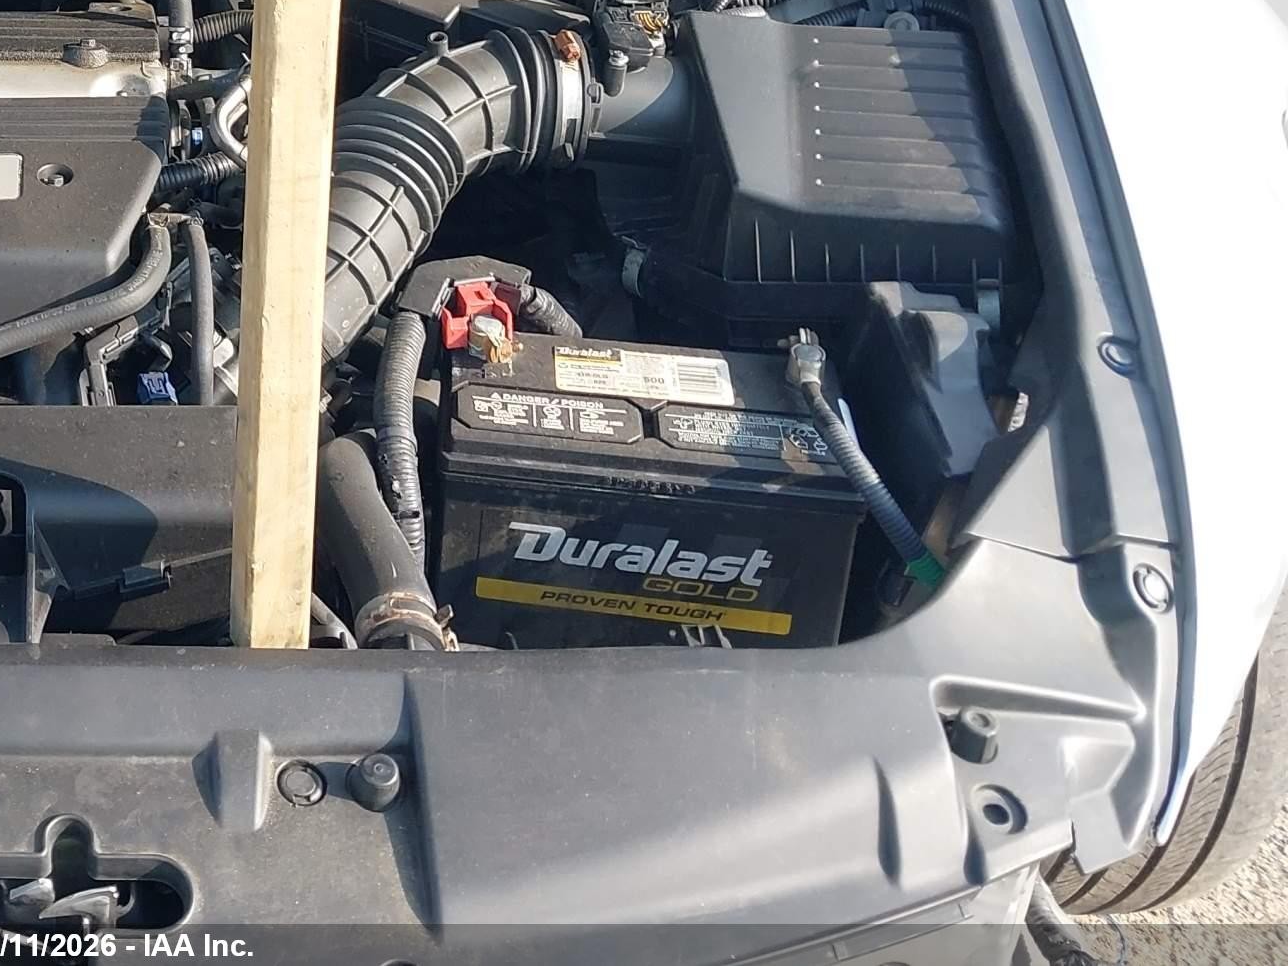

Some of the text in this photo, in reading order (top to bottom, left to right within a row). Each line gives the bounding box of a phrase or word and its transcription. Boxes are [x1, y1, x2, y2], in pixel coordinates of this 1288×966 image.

[556, 346, 613, 358] Duralast
[509, 521, 772, 586] Duralast
[642, 577, 759, 602] GOLD
[540, 590, 724, 621] PROVEN TOUGH
